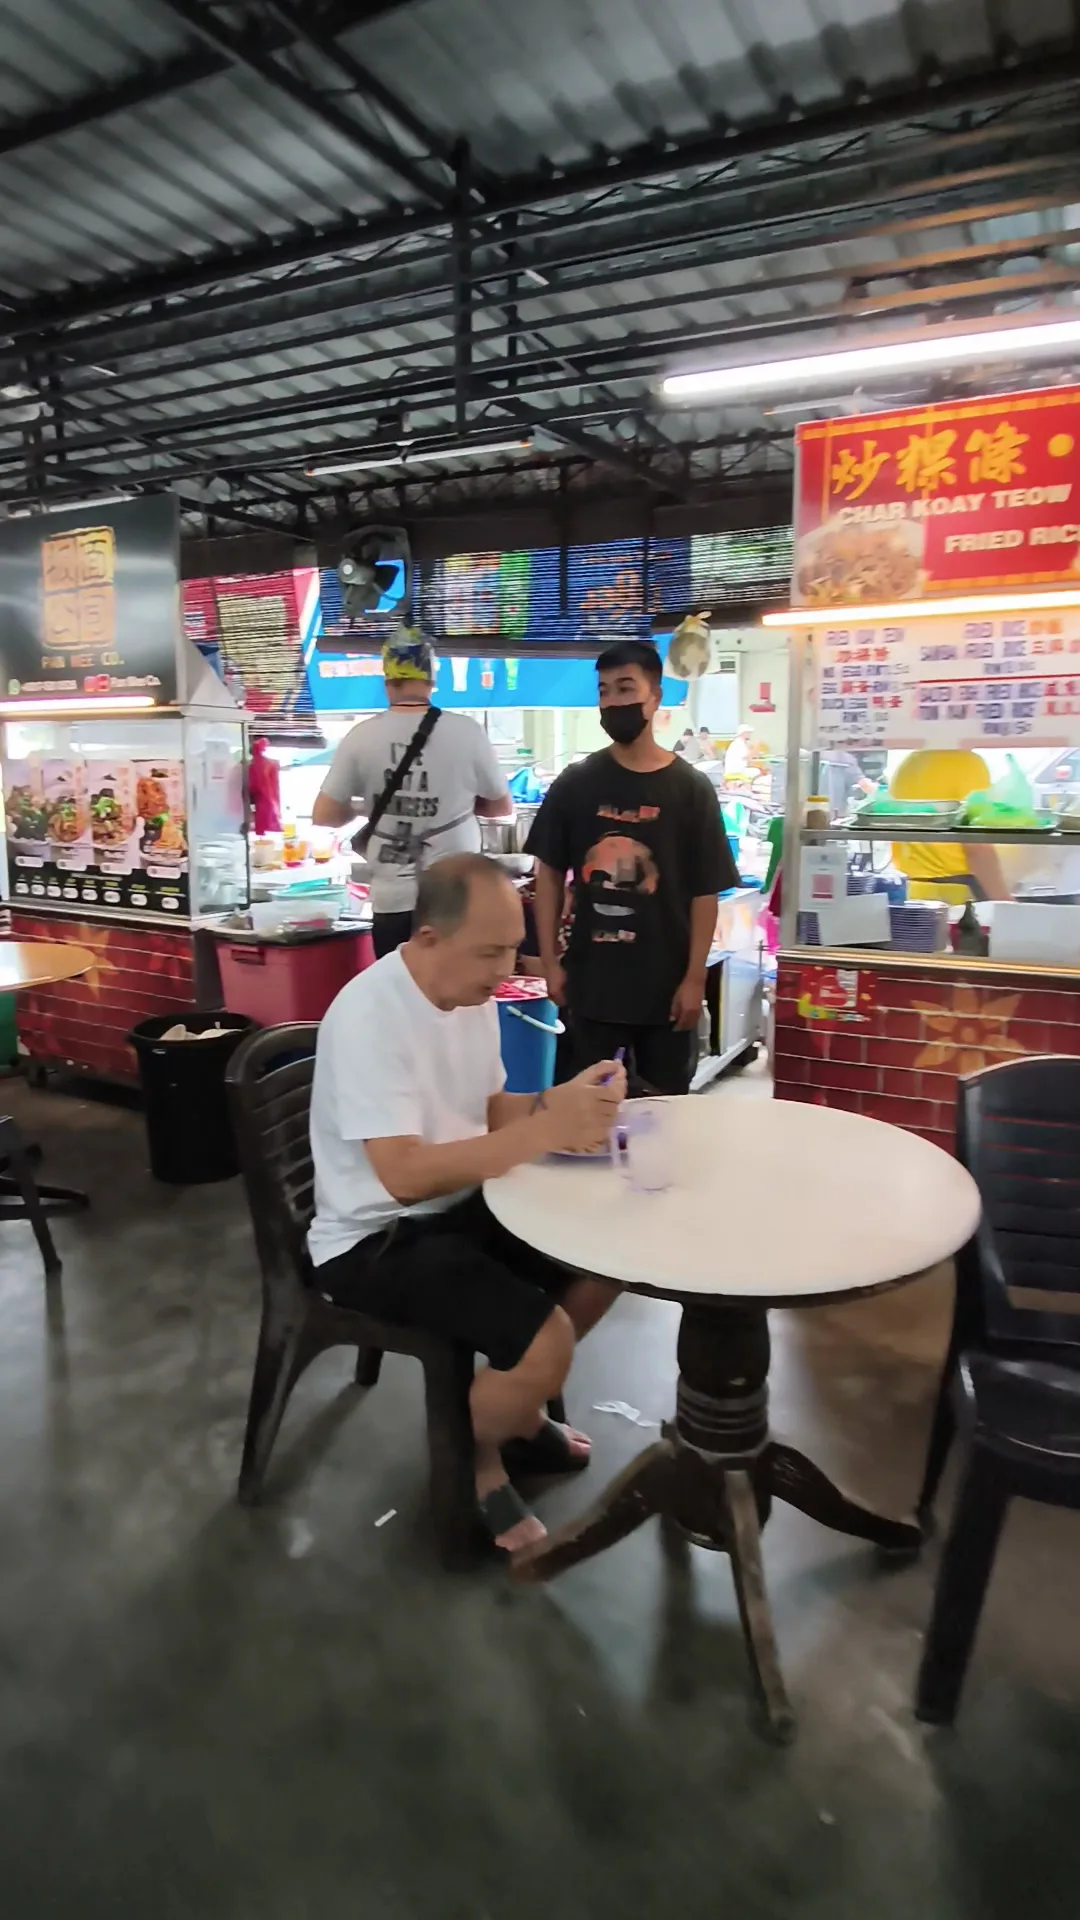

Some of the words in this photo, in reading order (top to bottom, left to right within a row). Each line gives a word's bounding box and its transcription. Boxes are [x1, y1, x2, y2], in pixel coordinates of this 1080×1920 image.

[838, 503, 906, 524] CHAR
[912, 493, 985, 517] KOAY
[992, 484, 1072, 508] TEOW
[945, 529, 1024, 553] FRIED
[1029, 524, 1080, 546] RIC
